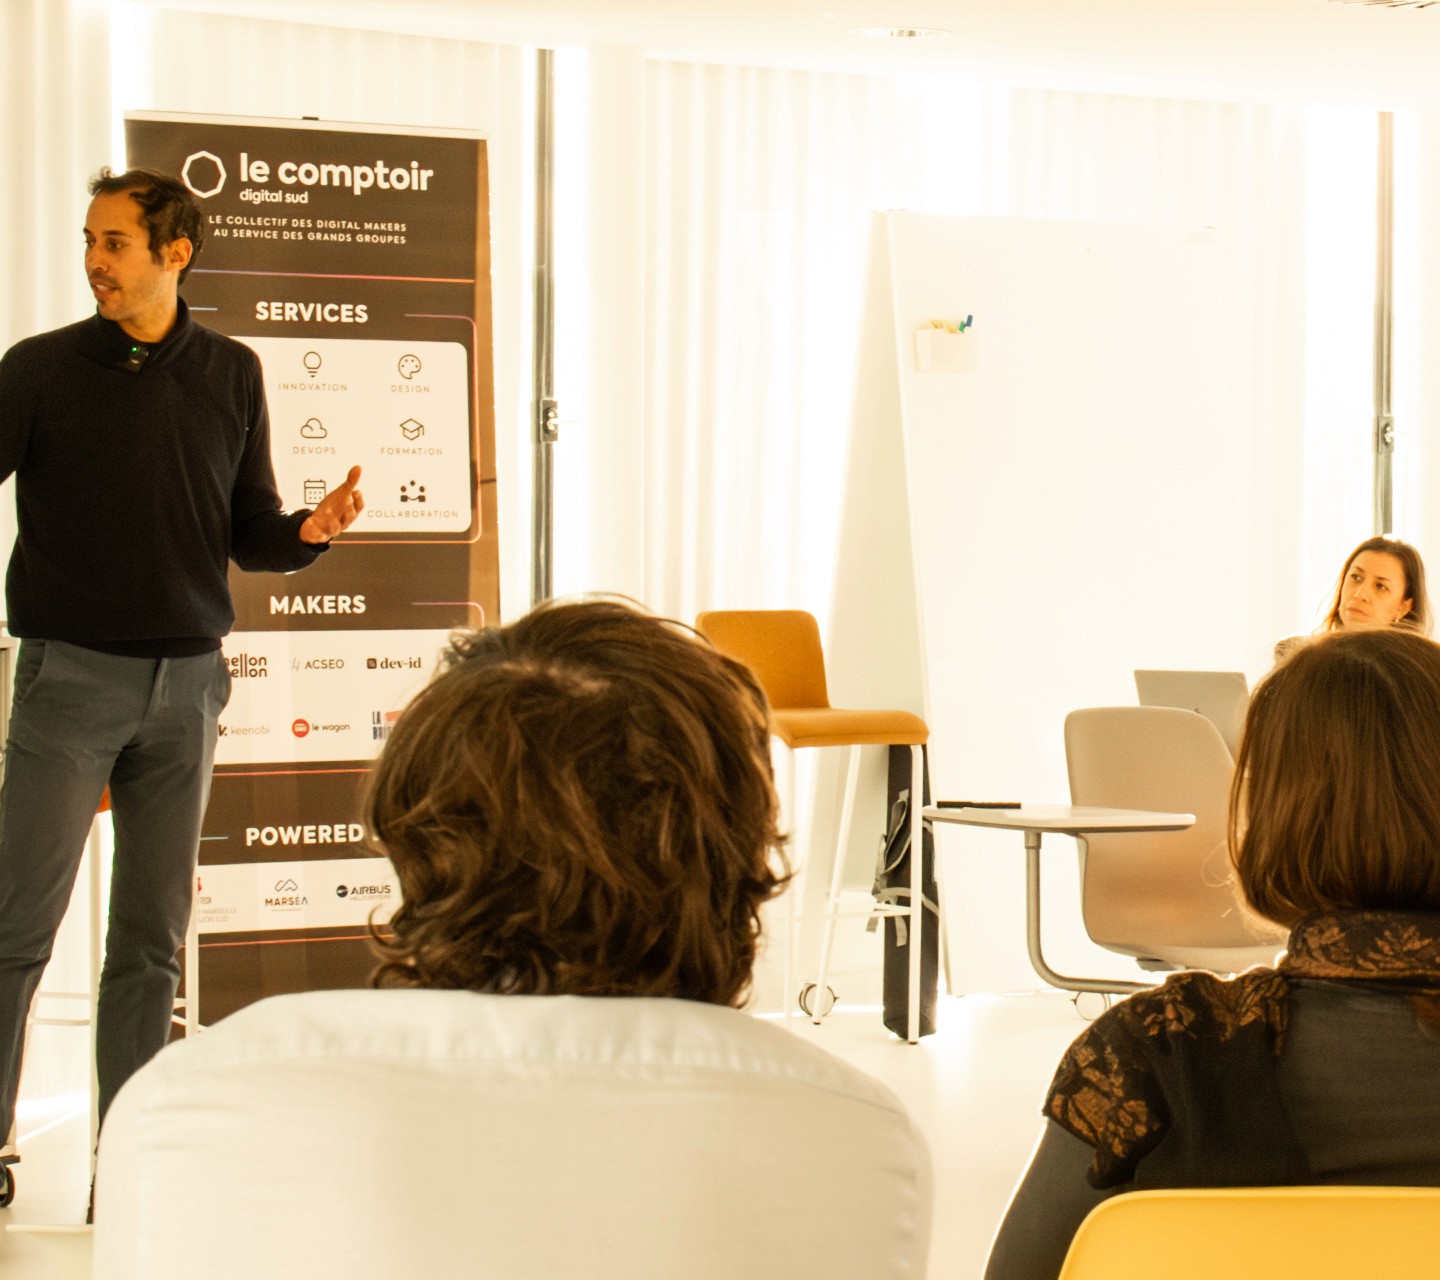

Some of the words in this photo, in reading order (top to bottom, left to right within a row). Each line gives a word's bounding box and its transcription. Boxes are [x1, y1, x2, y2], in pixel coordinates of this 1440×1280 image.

[240, 152, 270, 183] le
[278, 160, 434, 195] comptoir
[240, 189, 282, 205] digital
[285, 191, 309, 204] sud
[209, 215, 222, 224] LE
[226, 216, 288, 227] COLLECTIF
[292, 219, 313, 228] DES
[317, 220, 360, 230] DIGITAL
[364, 222, 407, 232] MAKERS
[214, 229, 228, 237] AU
[232, 229, 278, 239] SERVICE
[283, 231, 303, 240] DES
[308, 232, 352, 242] GRANDS
[356, 234, 407, 244] GROUPES
[255, 301, 369, 323] SERVICES
[278, 383, 348, 391] INNOVATION
[390, 385, 430, 393] DESIGN
[292, 446, 336, 455] DEVOPS
[380, 447, 443, 456] FORMATION
[367, 509, 459, 518] COLLABORATION
[269, 594, 367, 615] MAKERS
[305, 659, 345, 669] ACSEO
[380, 657, 421, 669] dev-id
[322, 724, 350, 733] wagon
[245, 823, 364, 846] POWERED
[351, 885, 391, 895] AIRBUS
